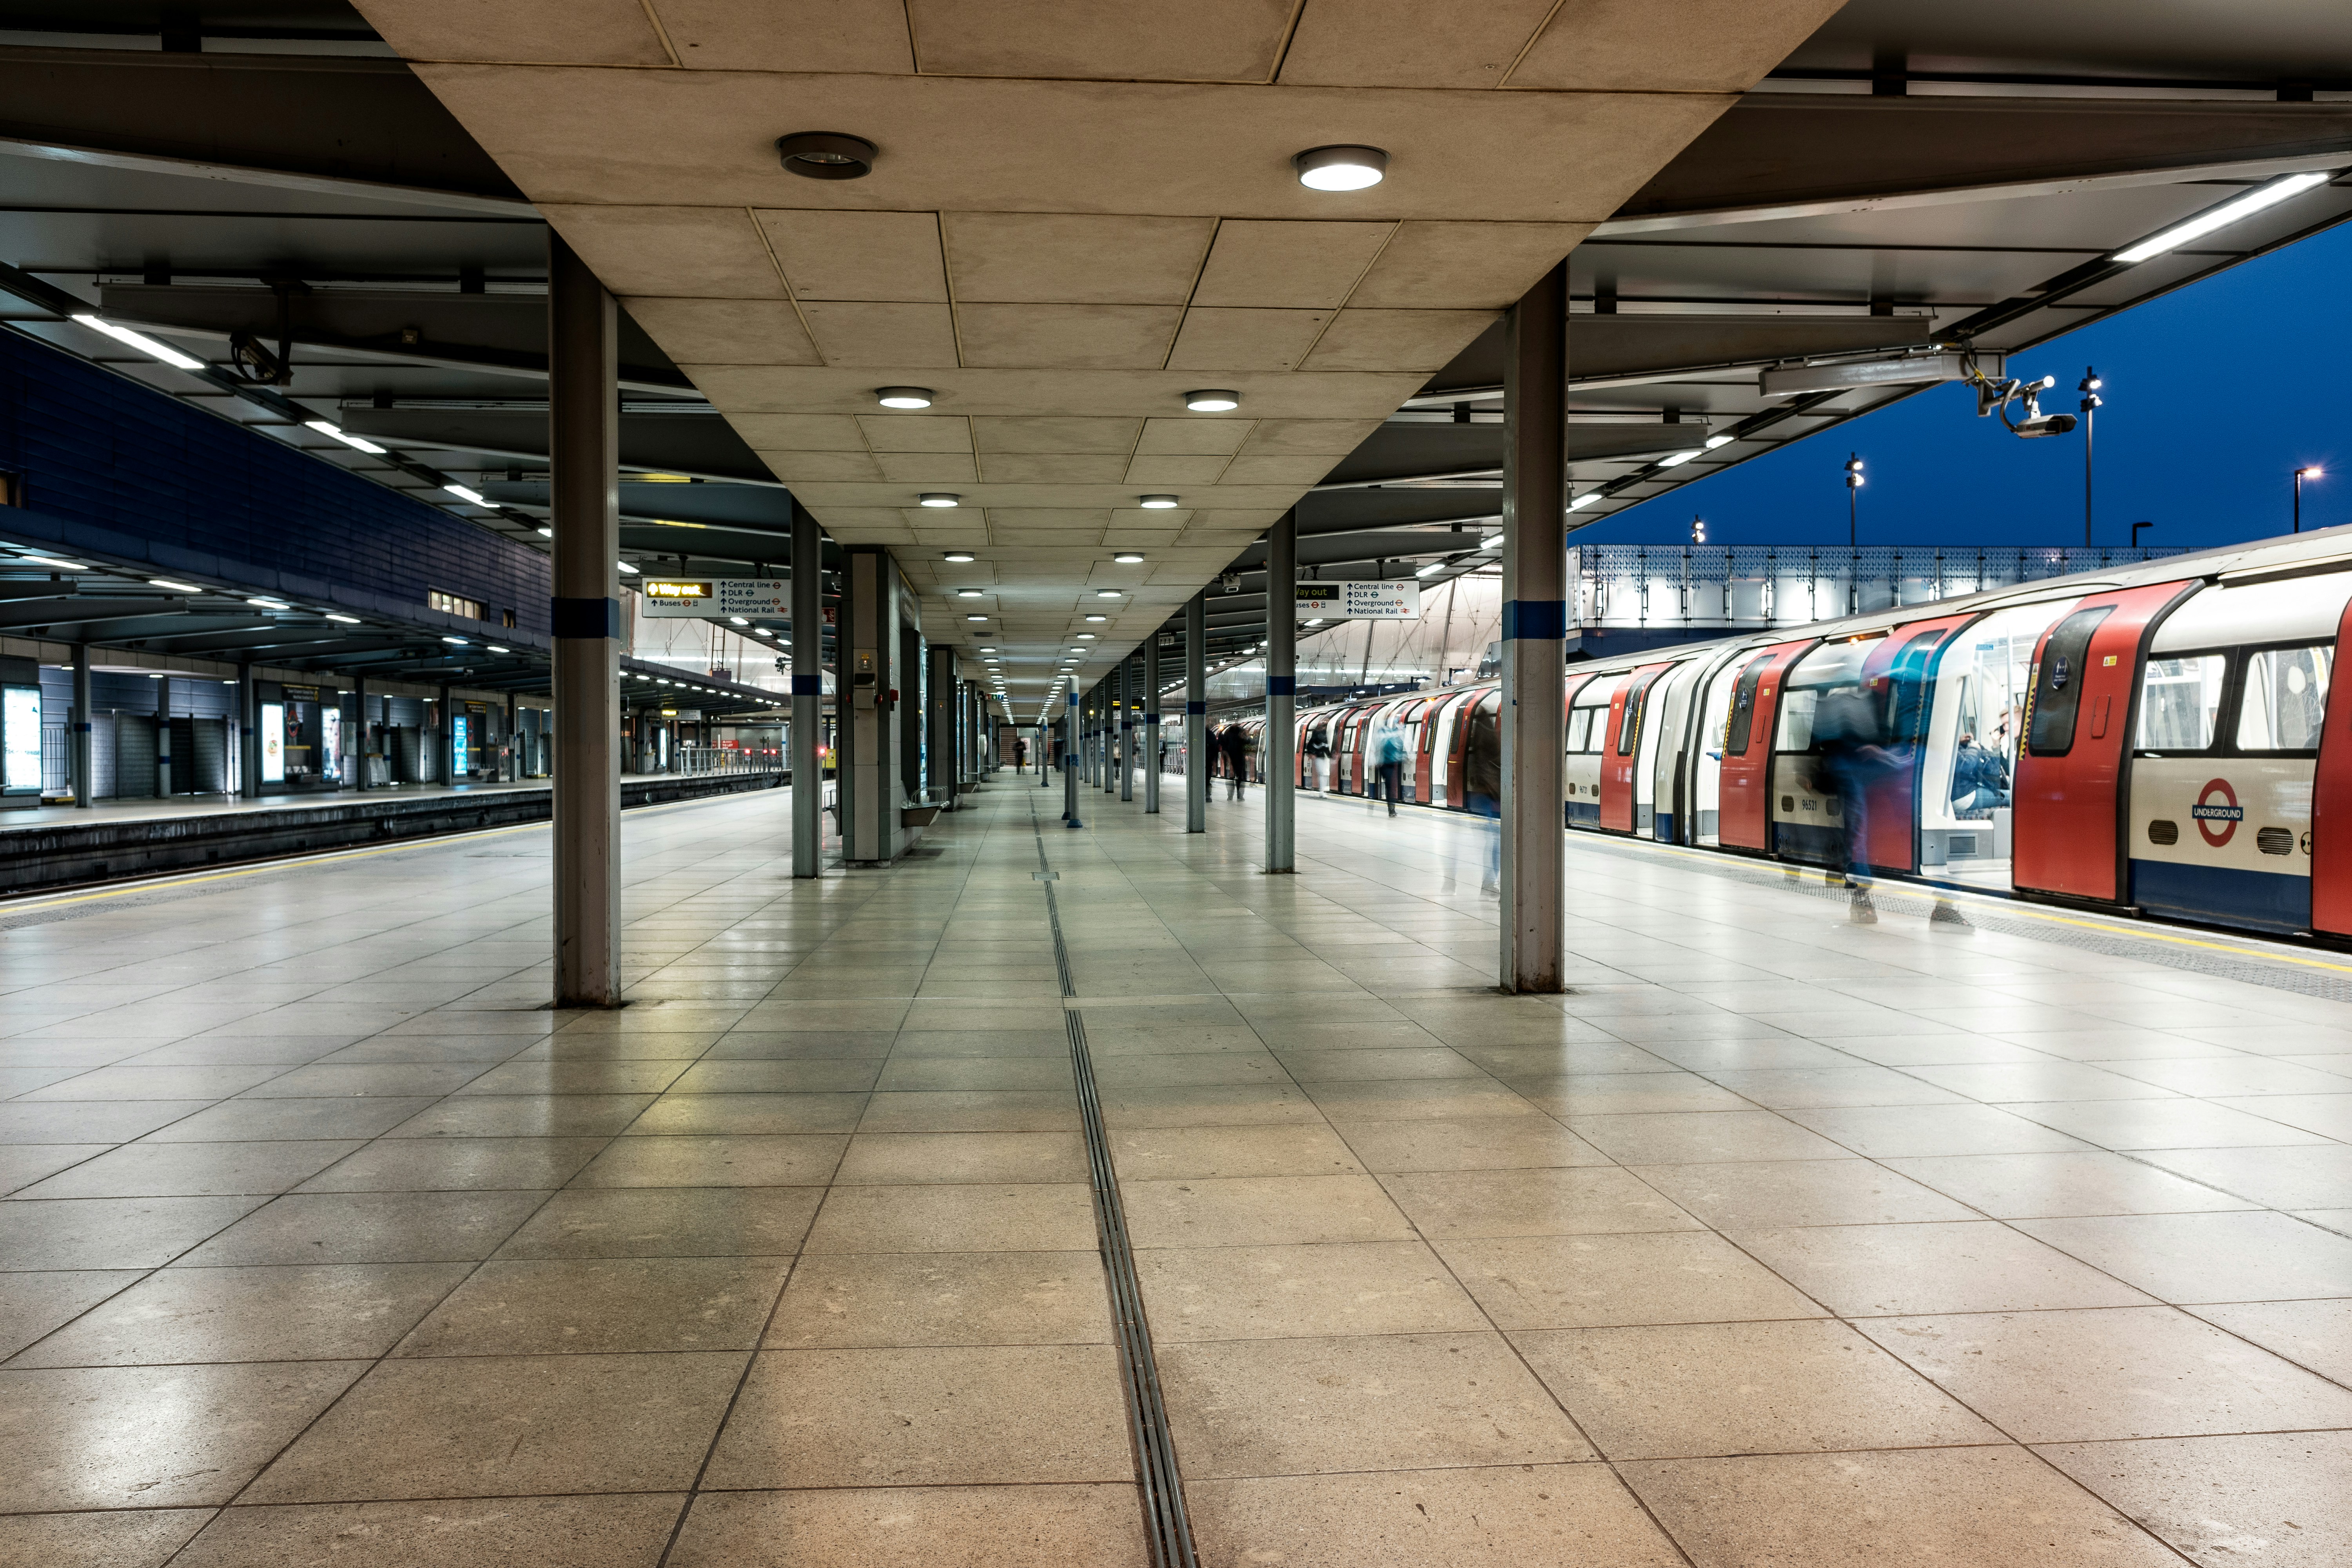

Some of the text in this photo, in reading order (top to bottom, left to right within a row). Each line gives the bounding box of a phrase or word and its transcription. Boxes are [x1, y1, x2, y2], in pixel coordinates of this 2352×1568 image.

[659, 584, 701, 596] Way out
[1802, 799, 1817, 811] 96521
[2194, 808, 2241, 818] UNDERGROUND
